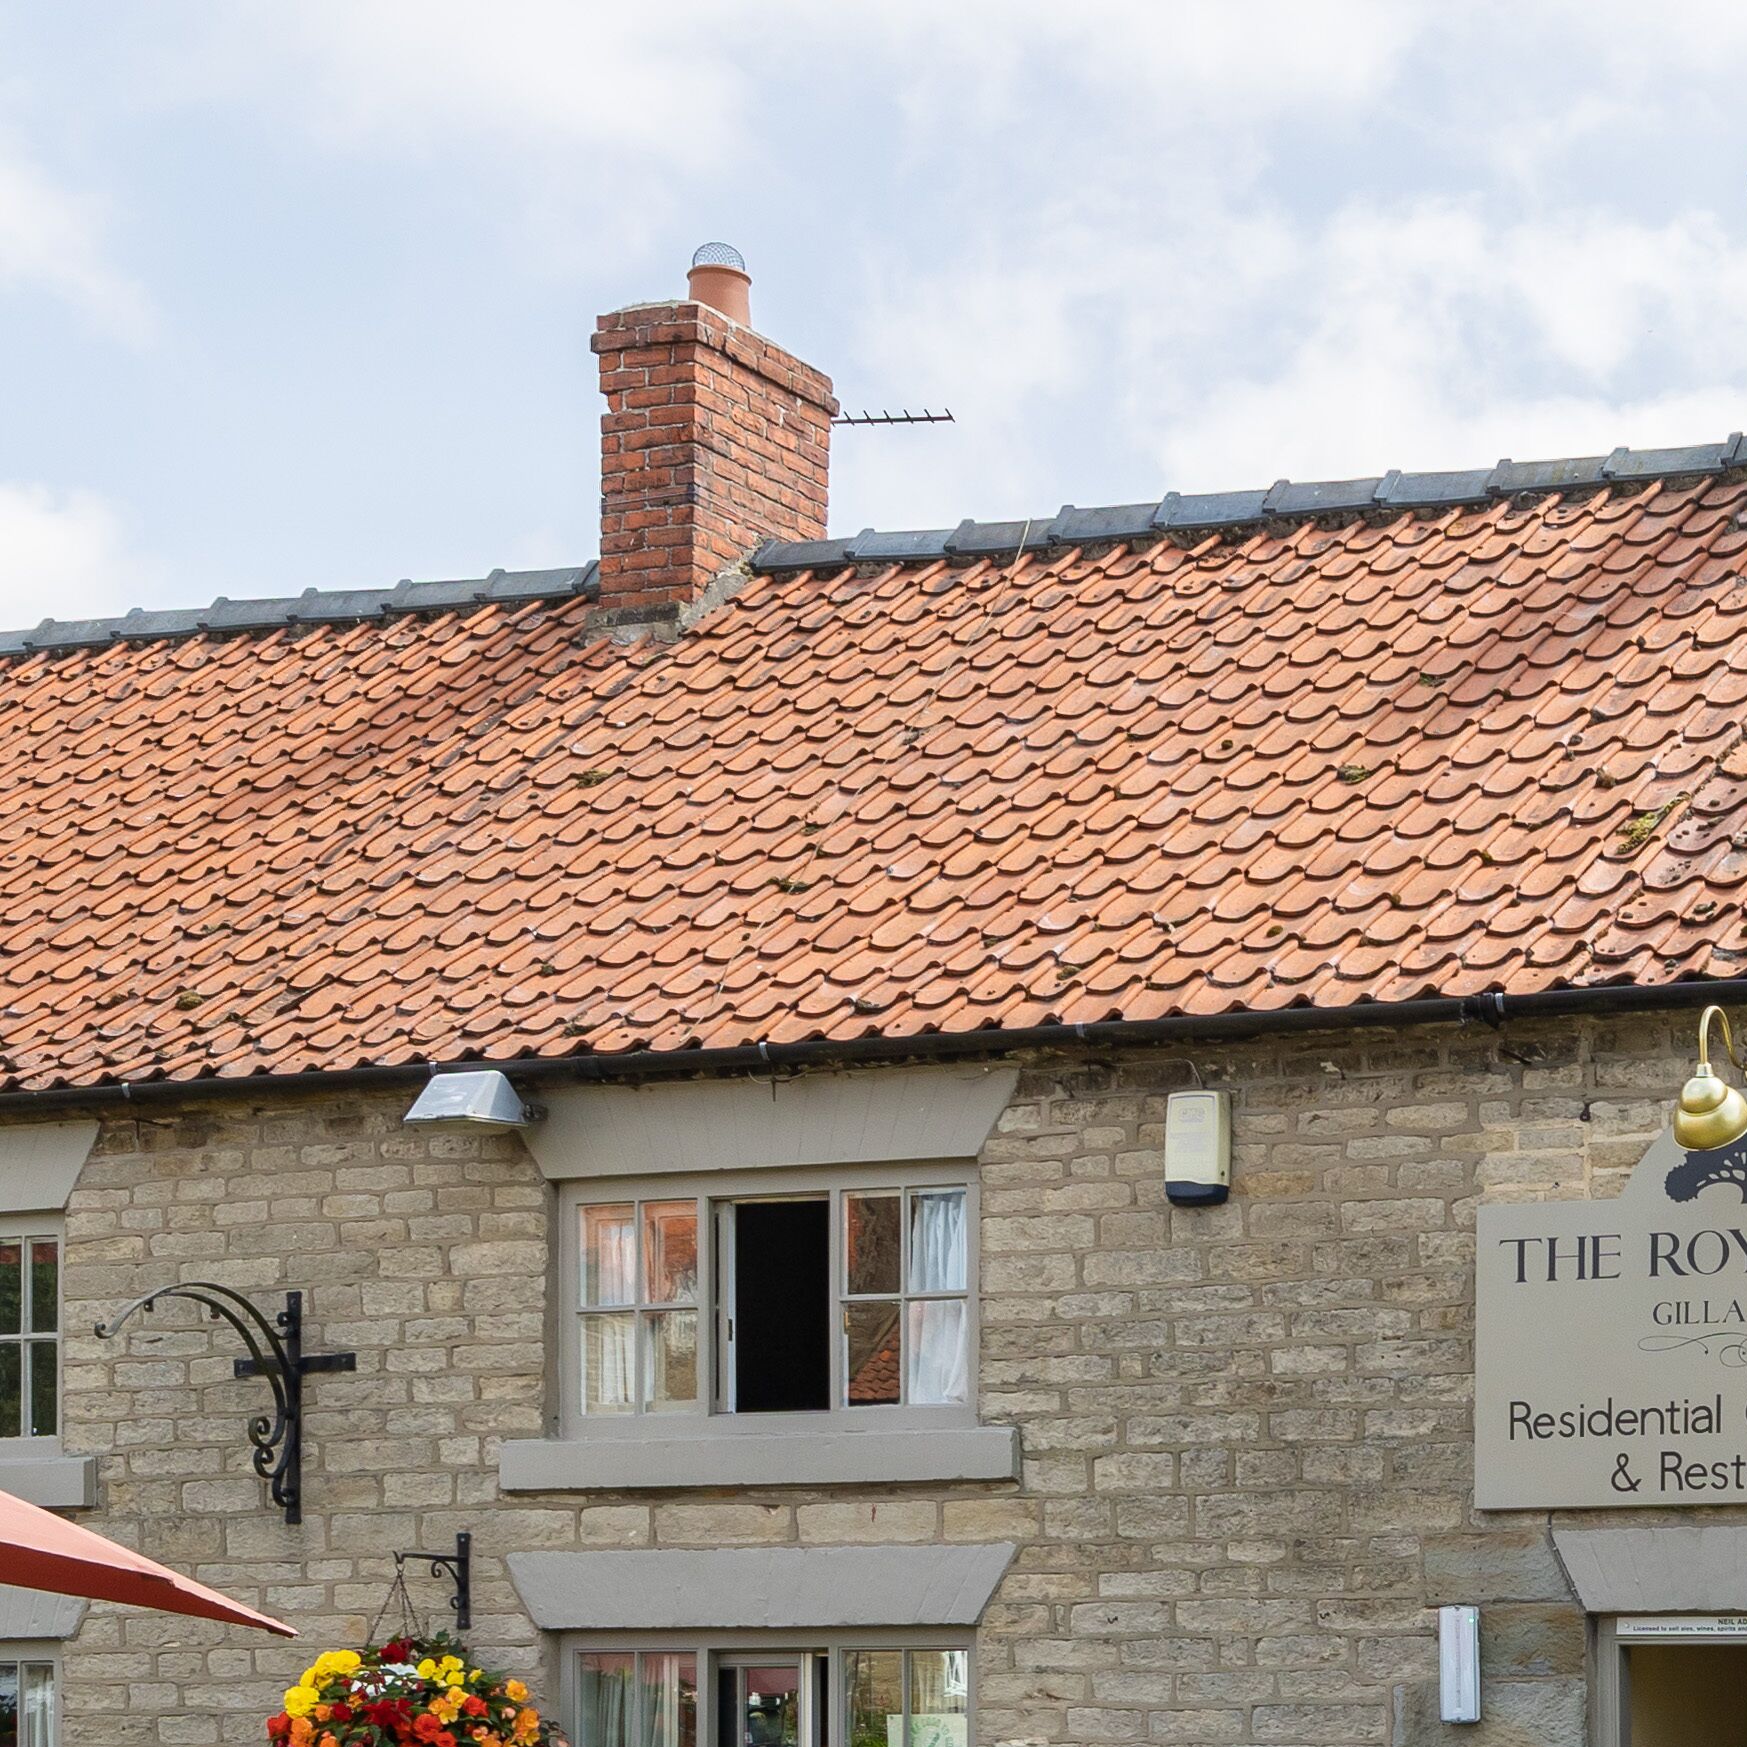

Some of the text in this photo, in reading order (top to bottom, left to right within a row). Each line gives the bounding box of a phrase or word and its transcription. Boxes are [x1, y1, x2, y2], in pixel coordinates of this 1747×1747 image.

[1499, 1234, 1622, 1284] THE
[1508, 1394, 1722, 1441] Residential
[1610, 1452, 1642, 1493] &
